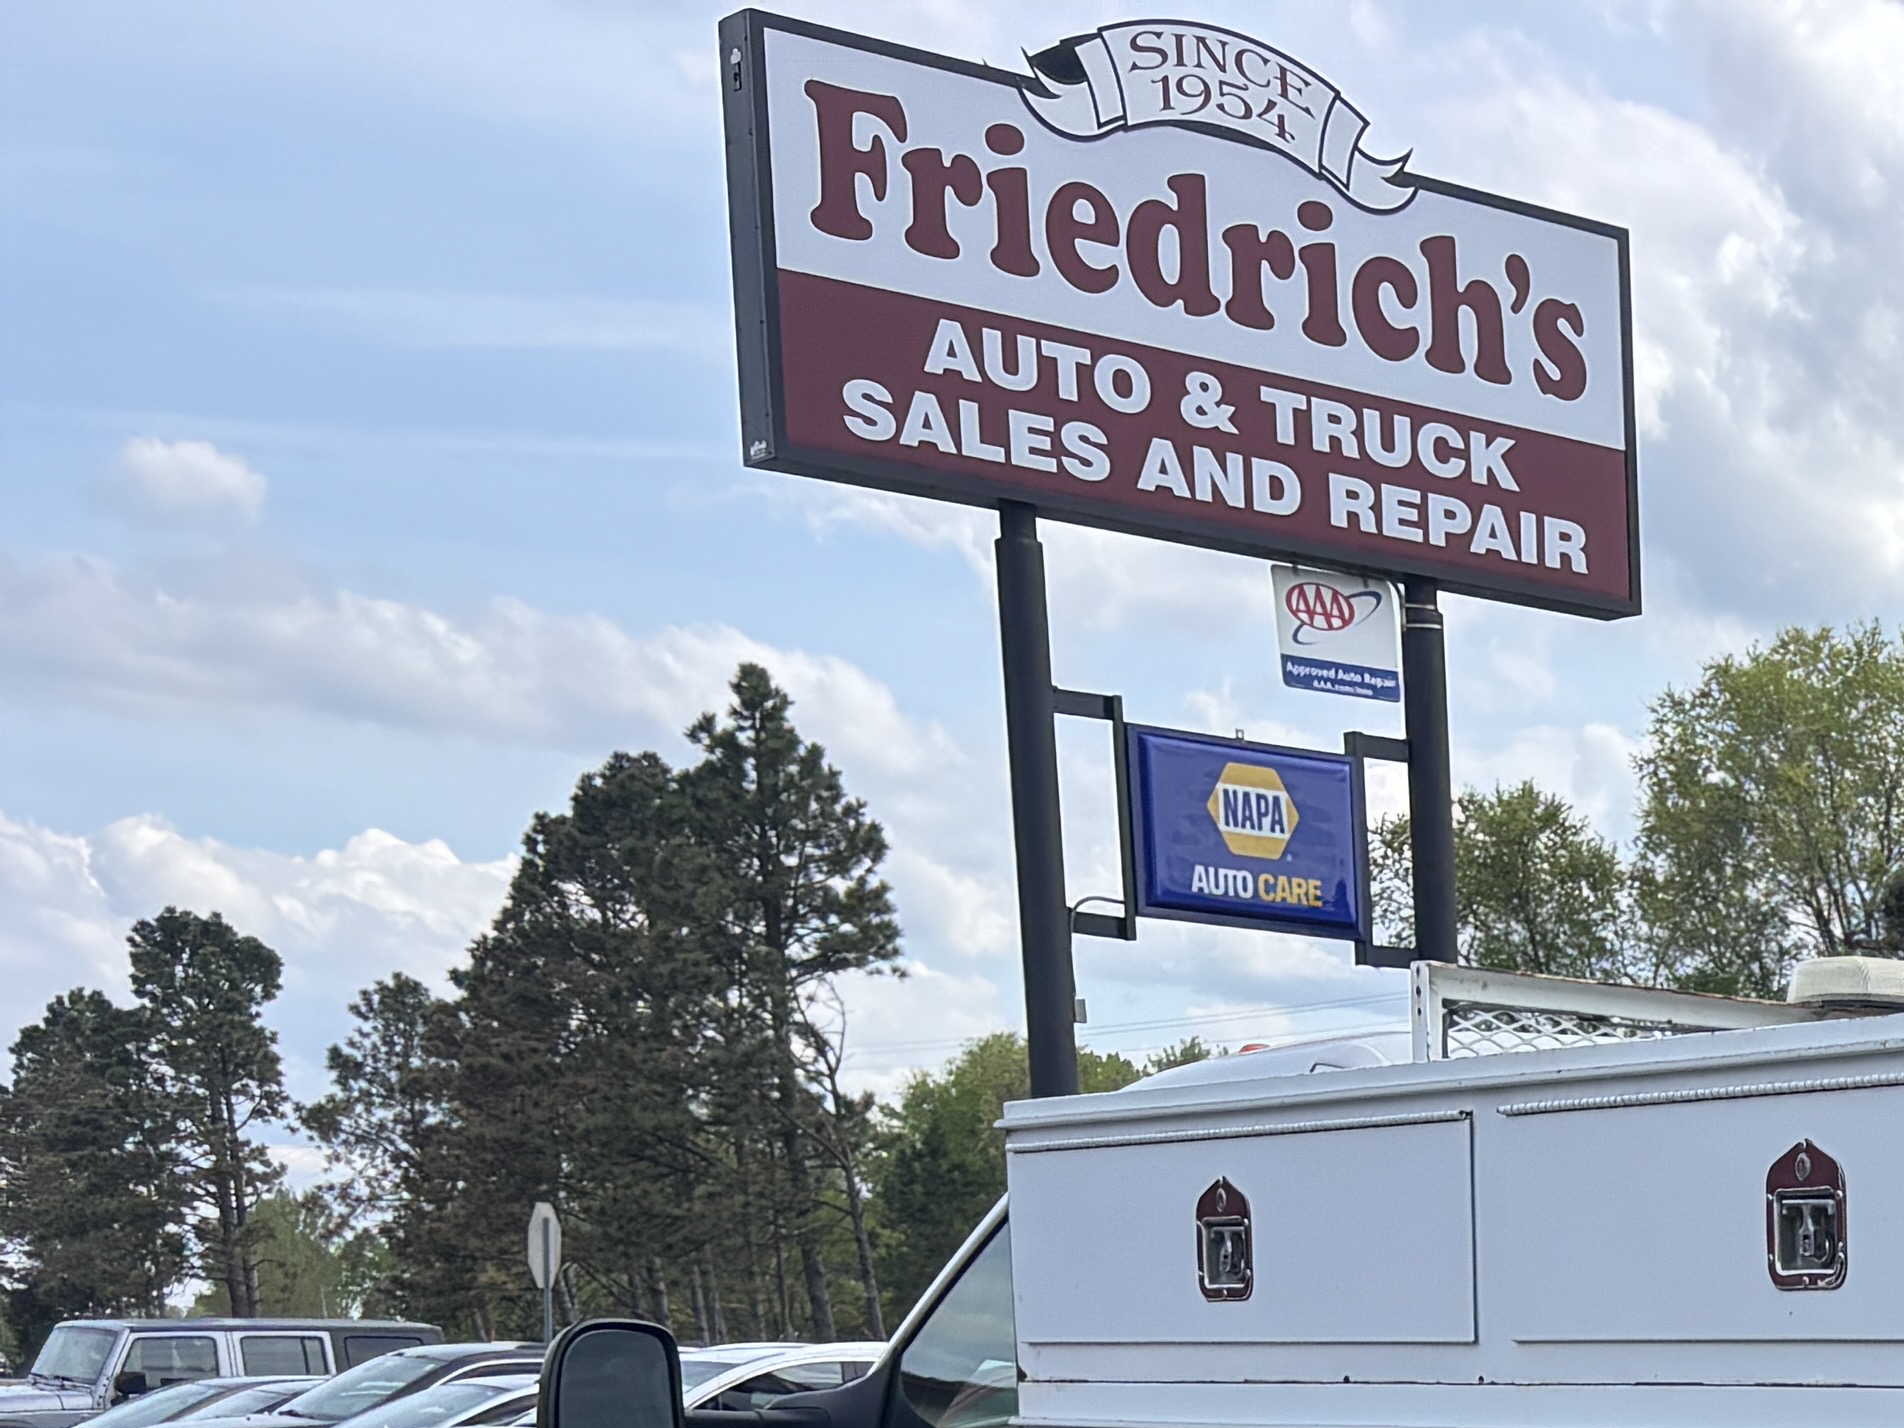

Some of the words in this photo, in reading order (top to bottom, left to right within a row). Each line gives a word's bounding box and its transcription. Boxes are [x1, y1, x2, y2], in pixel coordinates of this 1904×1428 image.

[1128, 31, 1314, 111] SINCE
[1157, 68, 1298, 145] 1954
[804, 78, 1588, 402] Friedrich's
[923, 319, 1153, 415] AUTO
[1180, 370, 1239, 435] &
[1261, 386, 1519, 493] TRUCK
[842, 378, 1112, 482] SALES
[1137, 438, 1303, 518] AND
[1329, 475, 1590, 575] REPAIR
[1290, 582, 1351, 631] AAA
[1286, 661, 1337, 679] Approved
[1221, 788, 1286, 835] NAPA
[1191, 865, 1254, 899] AUTO
[1257, 874, 1323, 907] CARE
